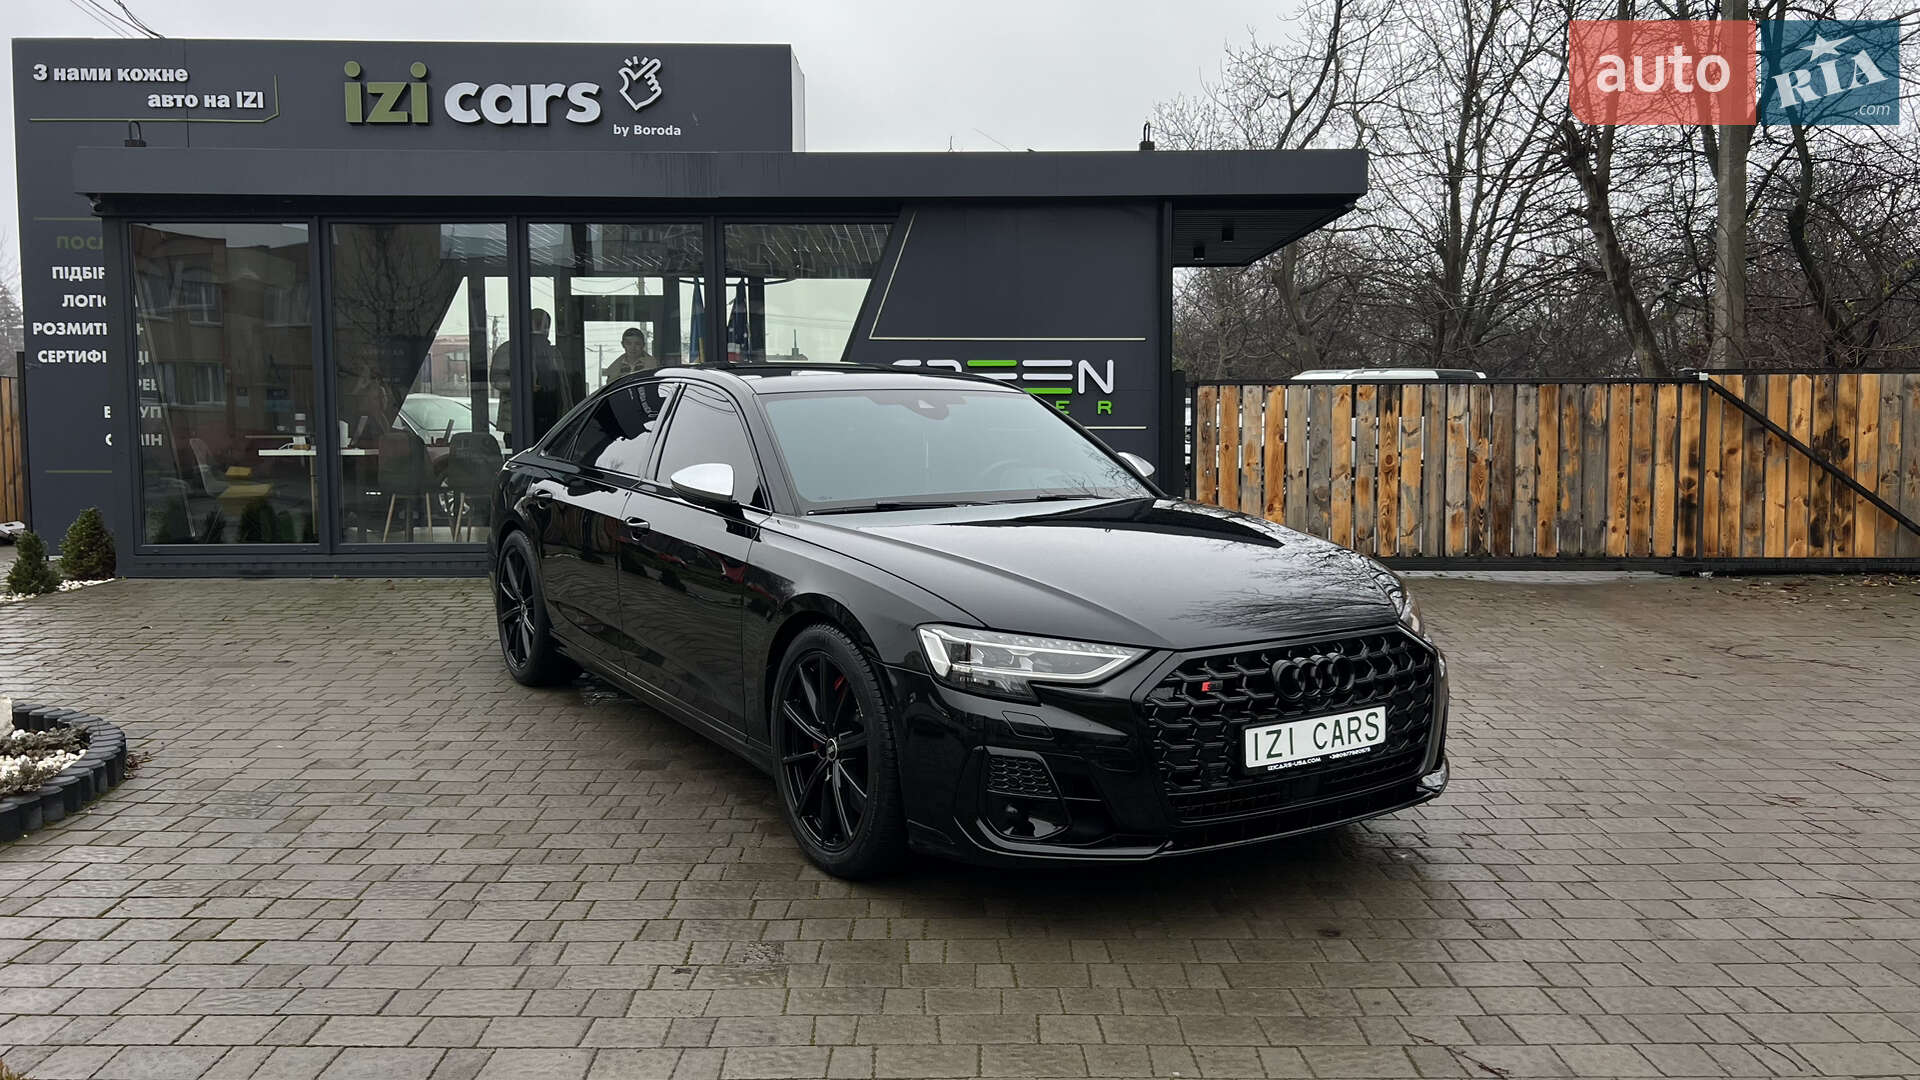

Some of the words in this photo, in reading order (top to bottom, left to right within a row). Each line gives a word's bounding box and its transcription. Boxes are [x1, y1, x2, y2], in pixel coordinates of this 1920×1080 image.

[53, 67, 112, 82] нами
[117, 67, 189, 82] кожне
[147, 93, 199, 109] авто
[204, 94, 231, 109] на
[236, 91, 265, 109] IZI
[344, 60, 430, 124] izi
[444, 81, 602, 125] cars
[613, 124, 630, 137] by
[633, 124, 682, 136] Boroda
[1254, 727, 1294, 761] IZI
[1313, 711, 1379, 750] CARS
